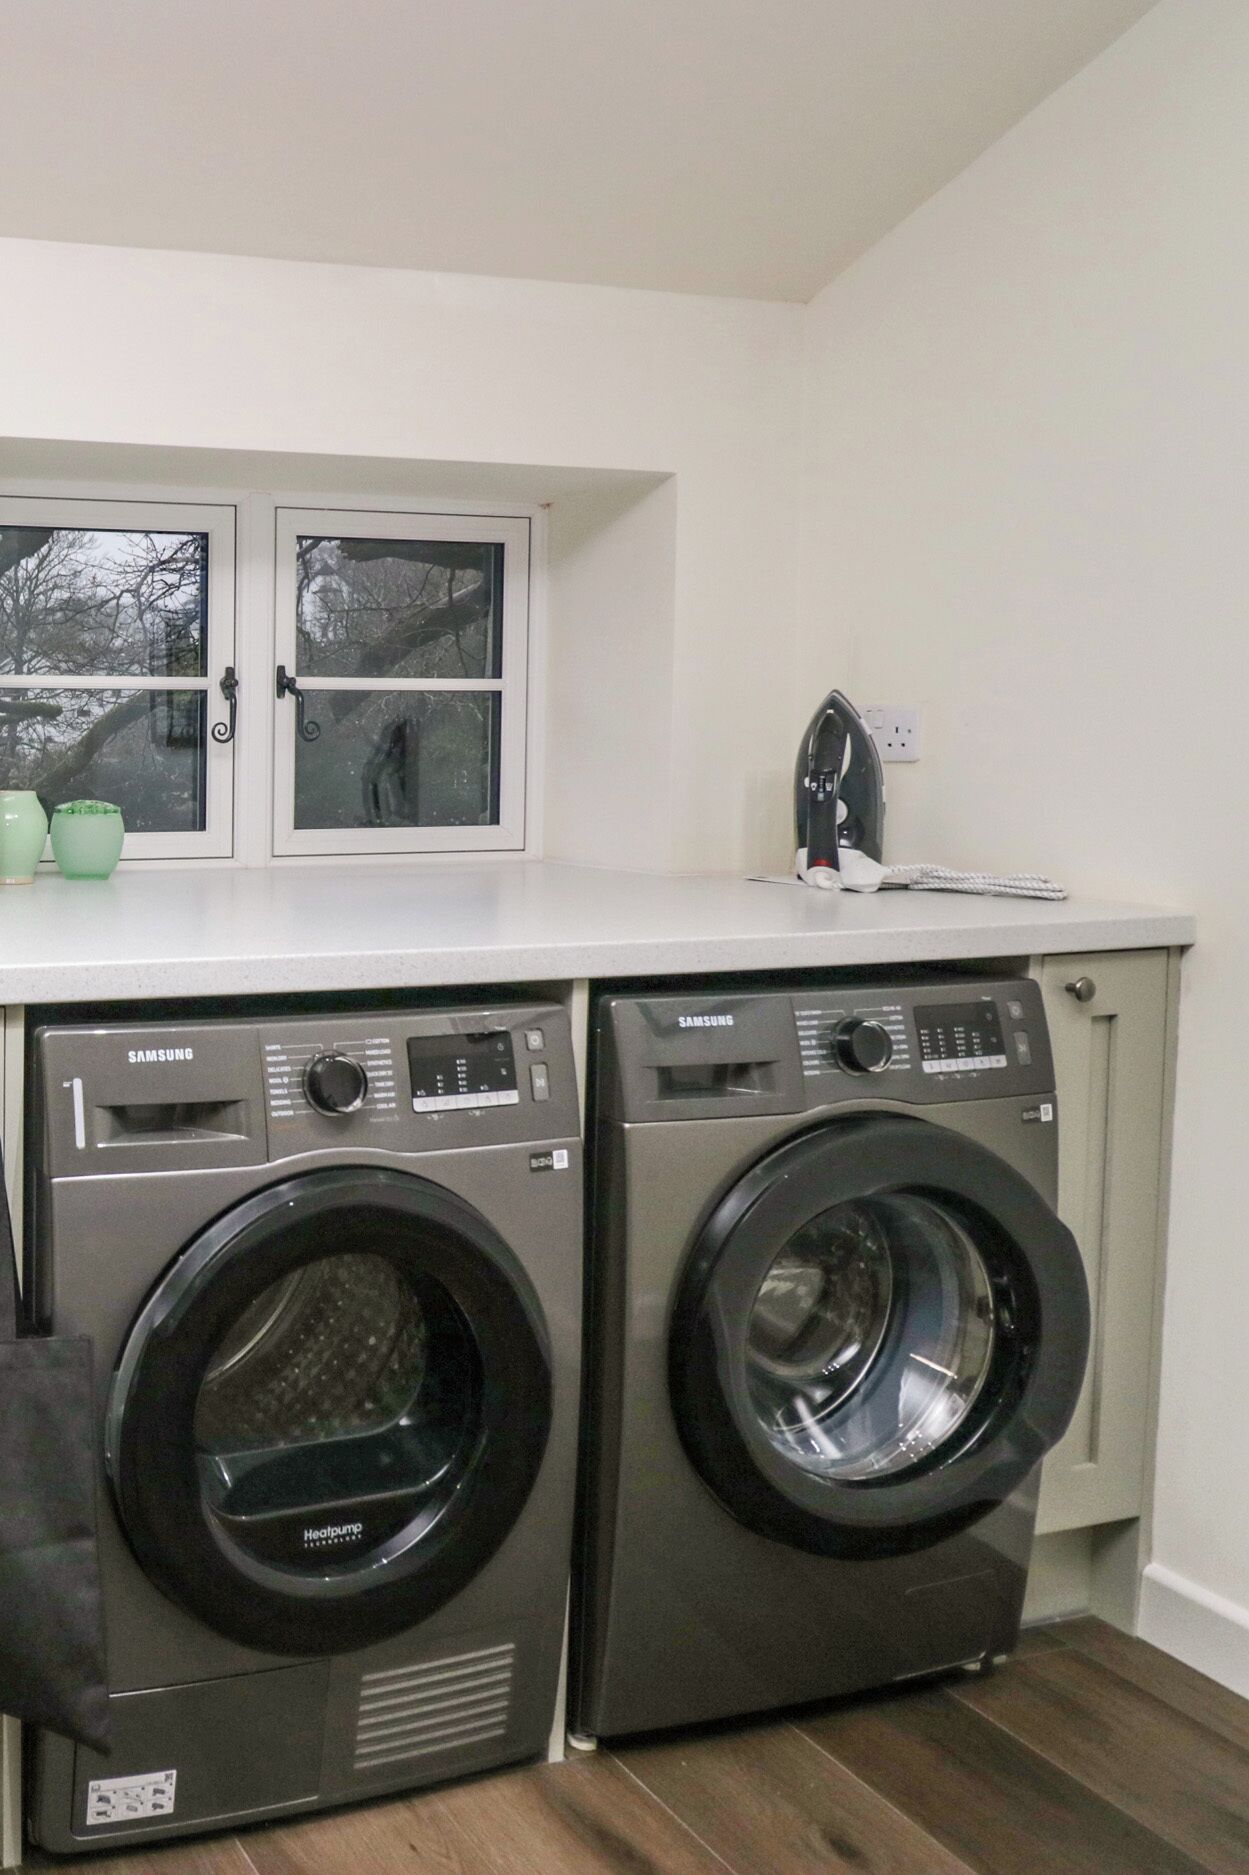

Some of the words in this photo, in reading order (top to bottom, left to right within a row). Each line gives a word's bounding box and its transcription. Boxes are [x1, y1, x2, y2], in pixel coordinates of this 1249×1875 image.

[678, 1014, 734, 1028] SAMSUNG
[127, 1047, 194, 1064] SAMSUNG
[303, 1522, 363, 1542] Heatpump
